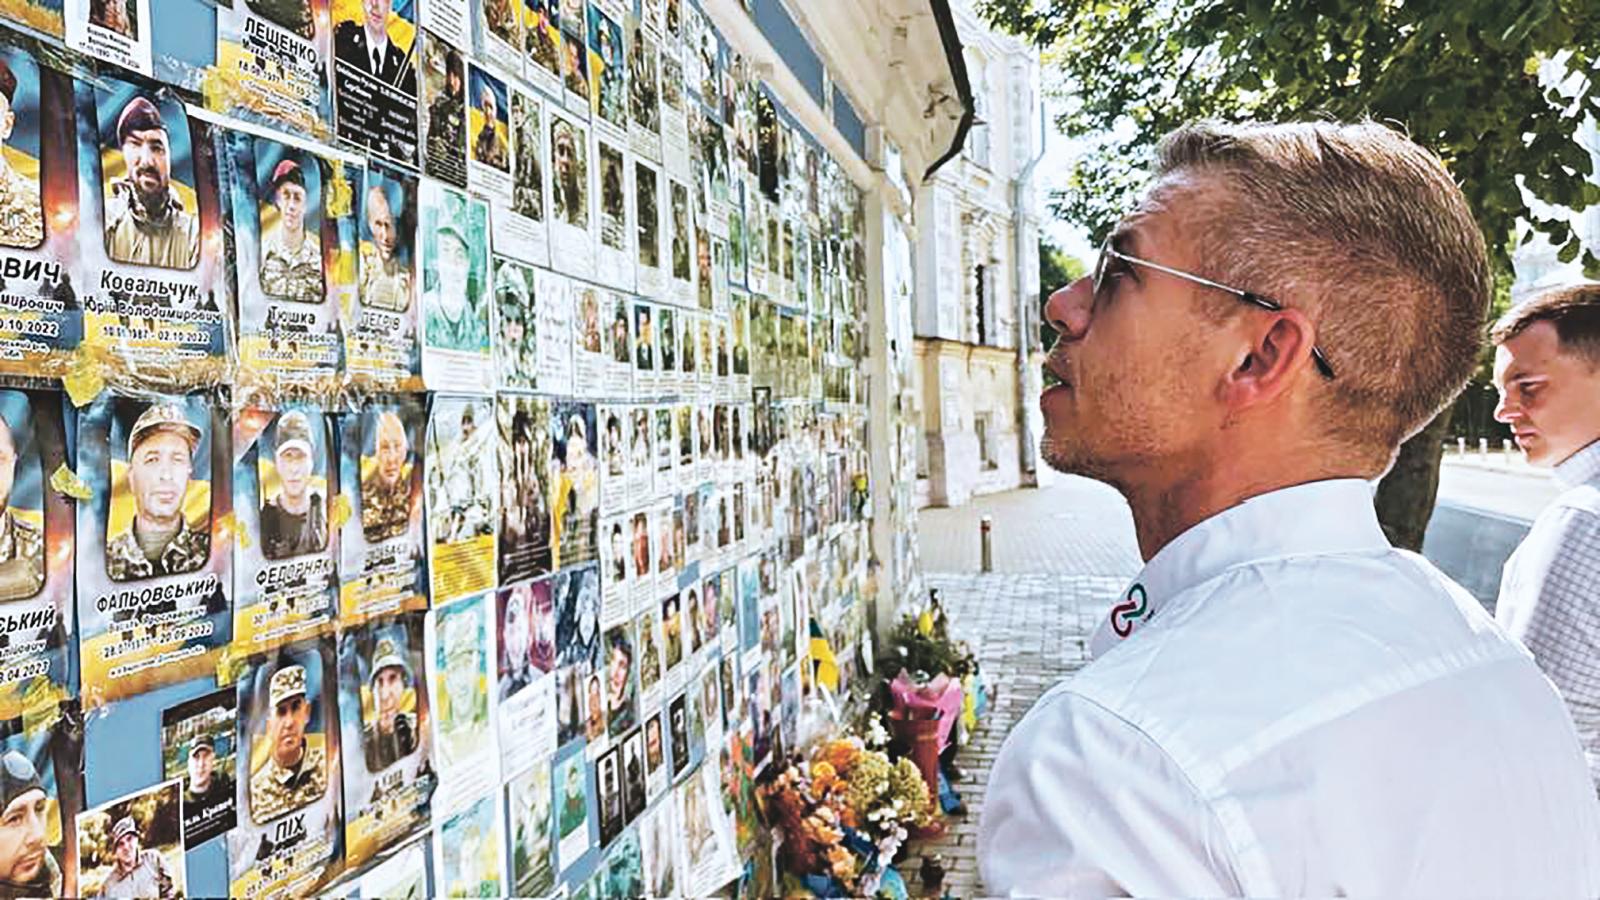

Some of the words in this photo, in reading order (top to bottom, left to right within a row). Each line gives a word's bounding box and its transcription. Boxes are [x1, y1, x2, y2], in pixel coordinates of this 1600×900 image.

[244, 17, 317, 64] ЛЕЩЕНКО
[0, 256, 60, 284] ВИЧ
[101, 270, 198, 304] Ковальчук
[97, 575, 216, 613] ФАЛЬОВСЬКИЙ
[275, 813, 305, 842] ПІХ
